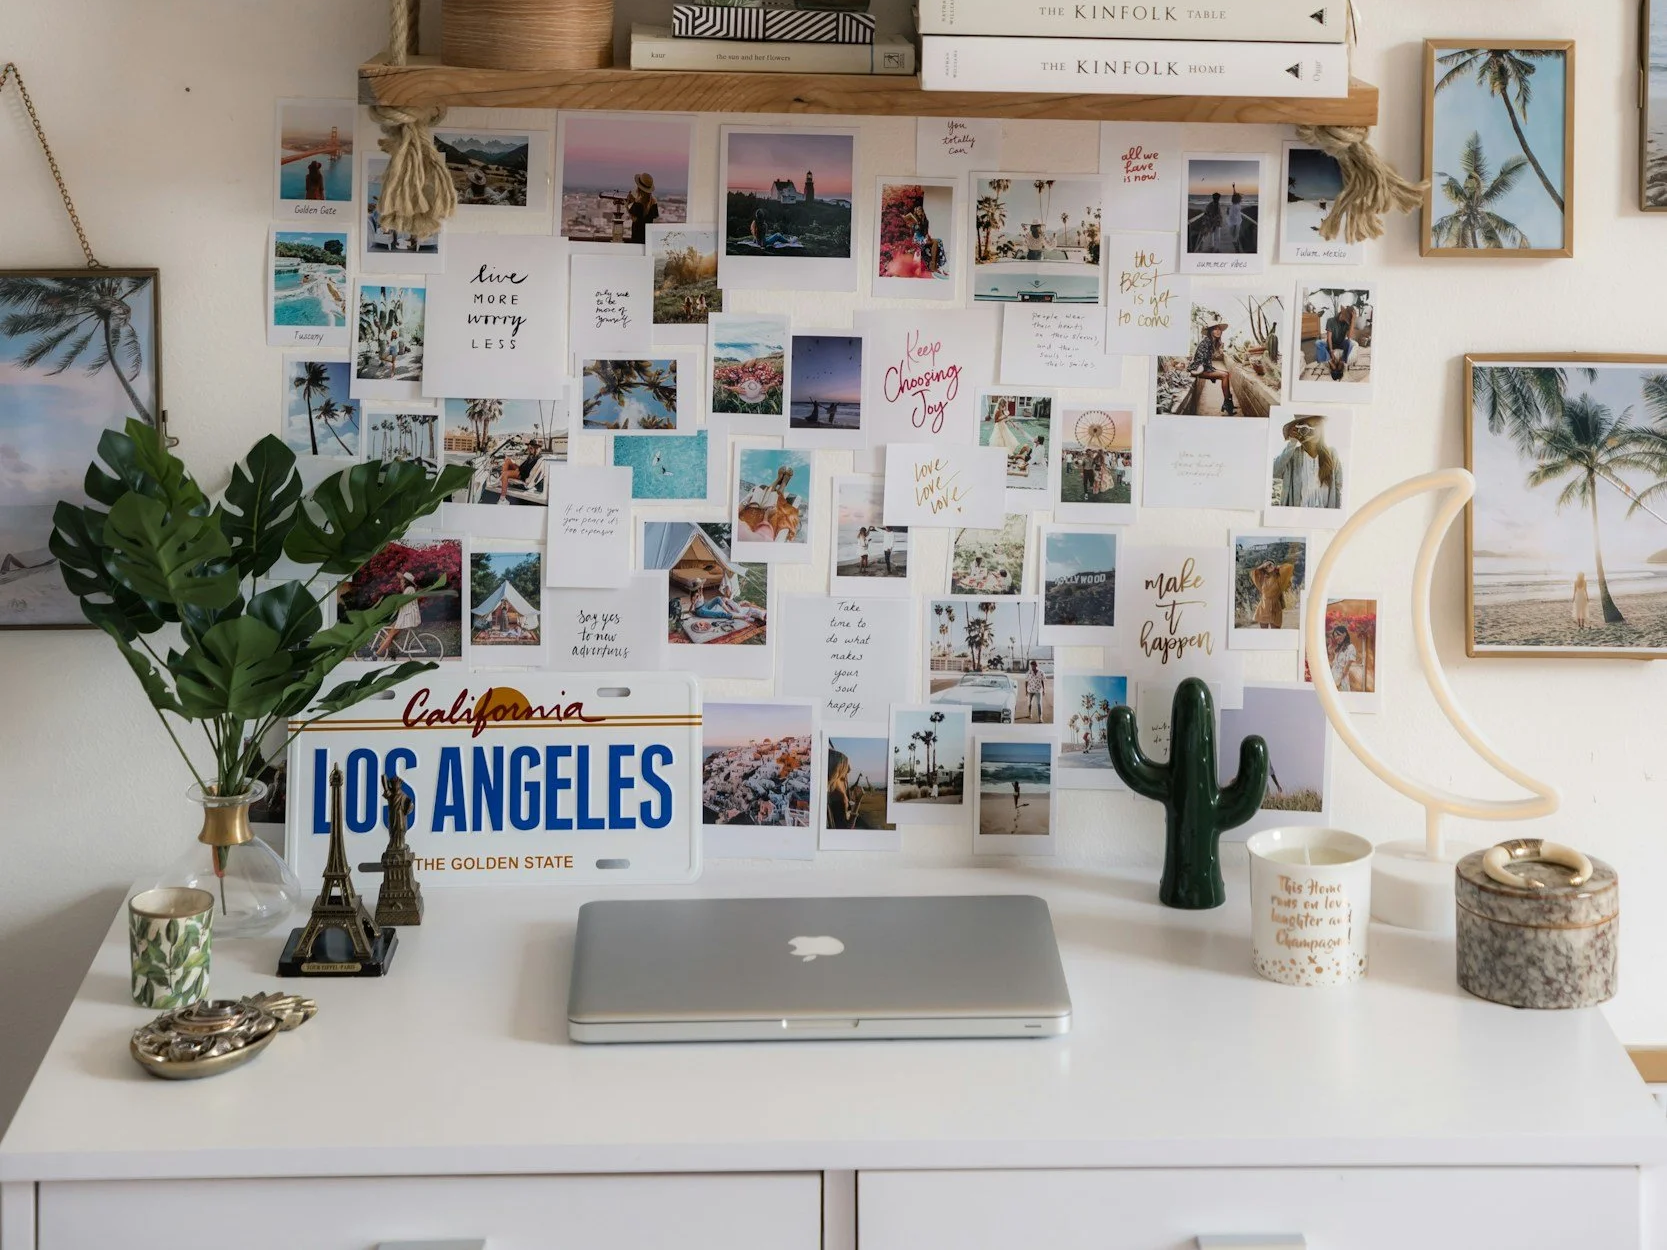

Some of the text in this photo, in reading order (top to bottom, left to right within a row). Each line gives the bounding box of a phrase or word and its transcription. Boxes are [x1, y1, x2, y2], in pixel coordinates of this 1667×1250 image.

[1039, 4, 1227, 21] THE KINFOLK TABLE
[651, 51, 666, 59] kaur
[716, 53, 727, 61] the
[1041, 59, 1226, 76] THE KINFOLK HOME
[942, 135, 976, 148] totally
[1121, 145, 1159, 161] all we
[1124, 160, 1153, 174] have
[1123, 175, 1131, 183] is
[294, 205, 337, 215] Golden Gate
[1134, 250, 1162, 269] the
[1196, 258, 1247, 268] summer vibes
[470, 264, 528, 284] live
[473, 294, 519, 305] MORE
[1133, 289, 1179, 315] is yet
[468, 313, 527, 337] worry
[1118, 309, 1170, 328] to come
[294, 330, 324, 346] Tuscany
[471, 339, 517, 350] LESS
[905, 329, 941, 371] Keep
[884, 359, 962, 402] Choosing
[911, 388, 948, 434] Joy
[1145, 557, 1205, 599] make
[837, 601, 860, 611] Take
[602, 613, 621, 631] yes
[830, 616, 867, 628] time to
[1155, 600, 1207, 635] it
[577, 626, 617, 642] to new
[825, 633, 870, 645] do what
[1139, 620, 1215, 664] happen
[830, 650, 863, 660] makes
[831, 669, 859, 685] your
[835, 683, 857, 693] soul
[402, 687, 606, 738] California
[431, 743, 674, 833] ANGELES
[414, 854, 574, 871] THE GOLDEN STATE
[1277, 874, 1342, 895] This Home
[1271, 895, 1298, 909] runs
[1303, 900, 1319, 910] on
[1271, 907, 1323, 931] laughter
